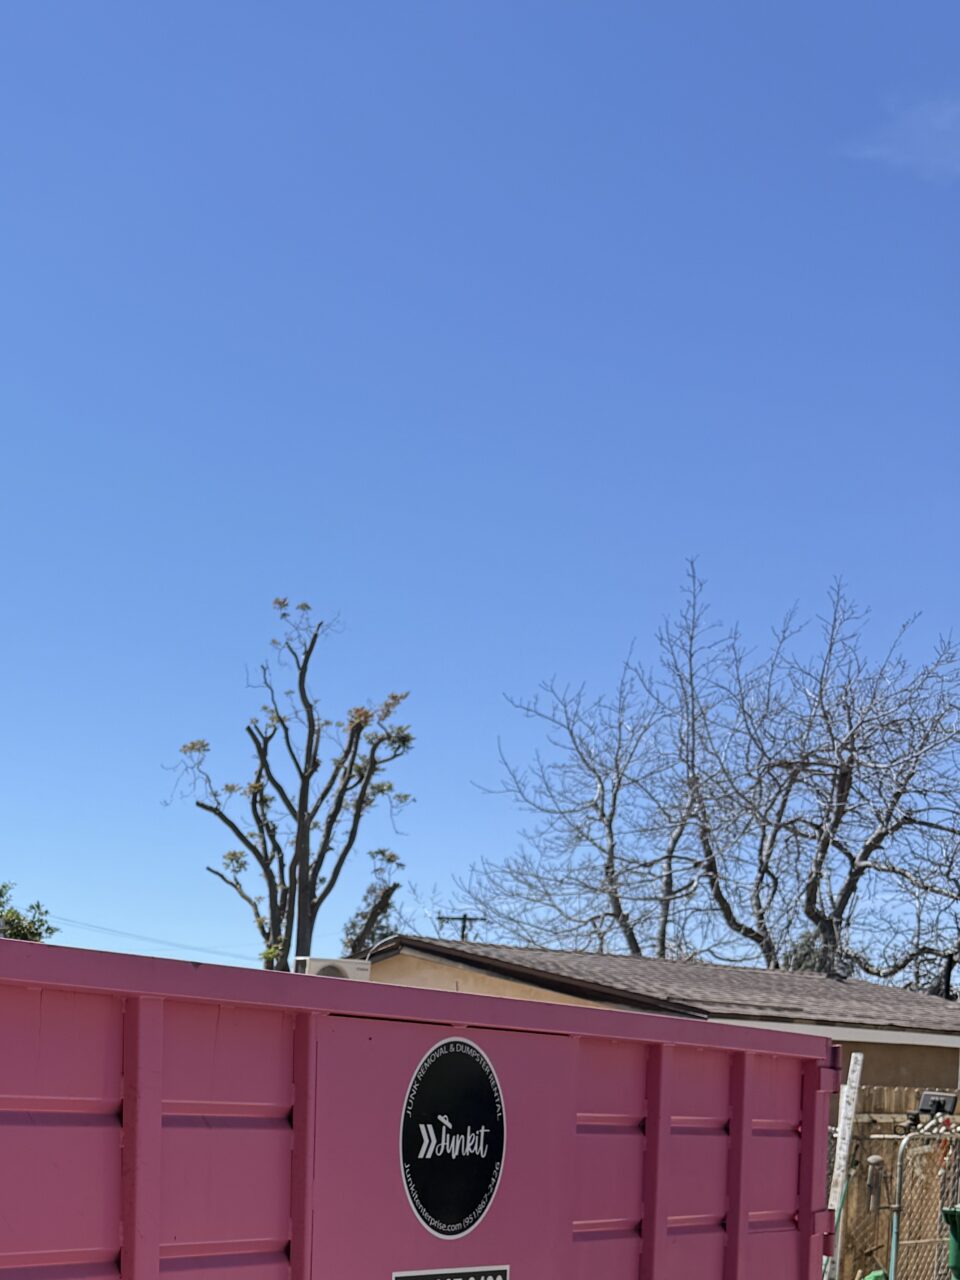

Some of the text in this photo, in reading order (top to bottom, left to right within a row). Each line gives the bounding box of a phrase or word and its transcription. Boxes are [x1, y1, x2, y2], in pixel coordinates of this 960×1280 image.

[406, 1043, 502, 1121] JUNK REMOVAL & DUMPSTER RENTAL
[435, 1123, 491, 1160] Junkit
